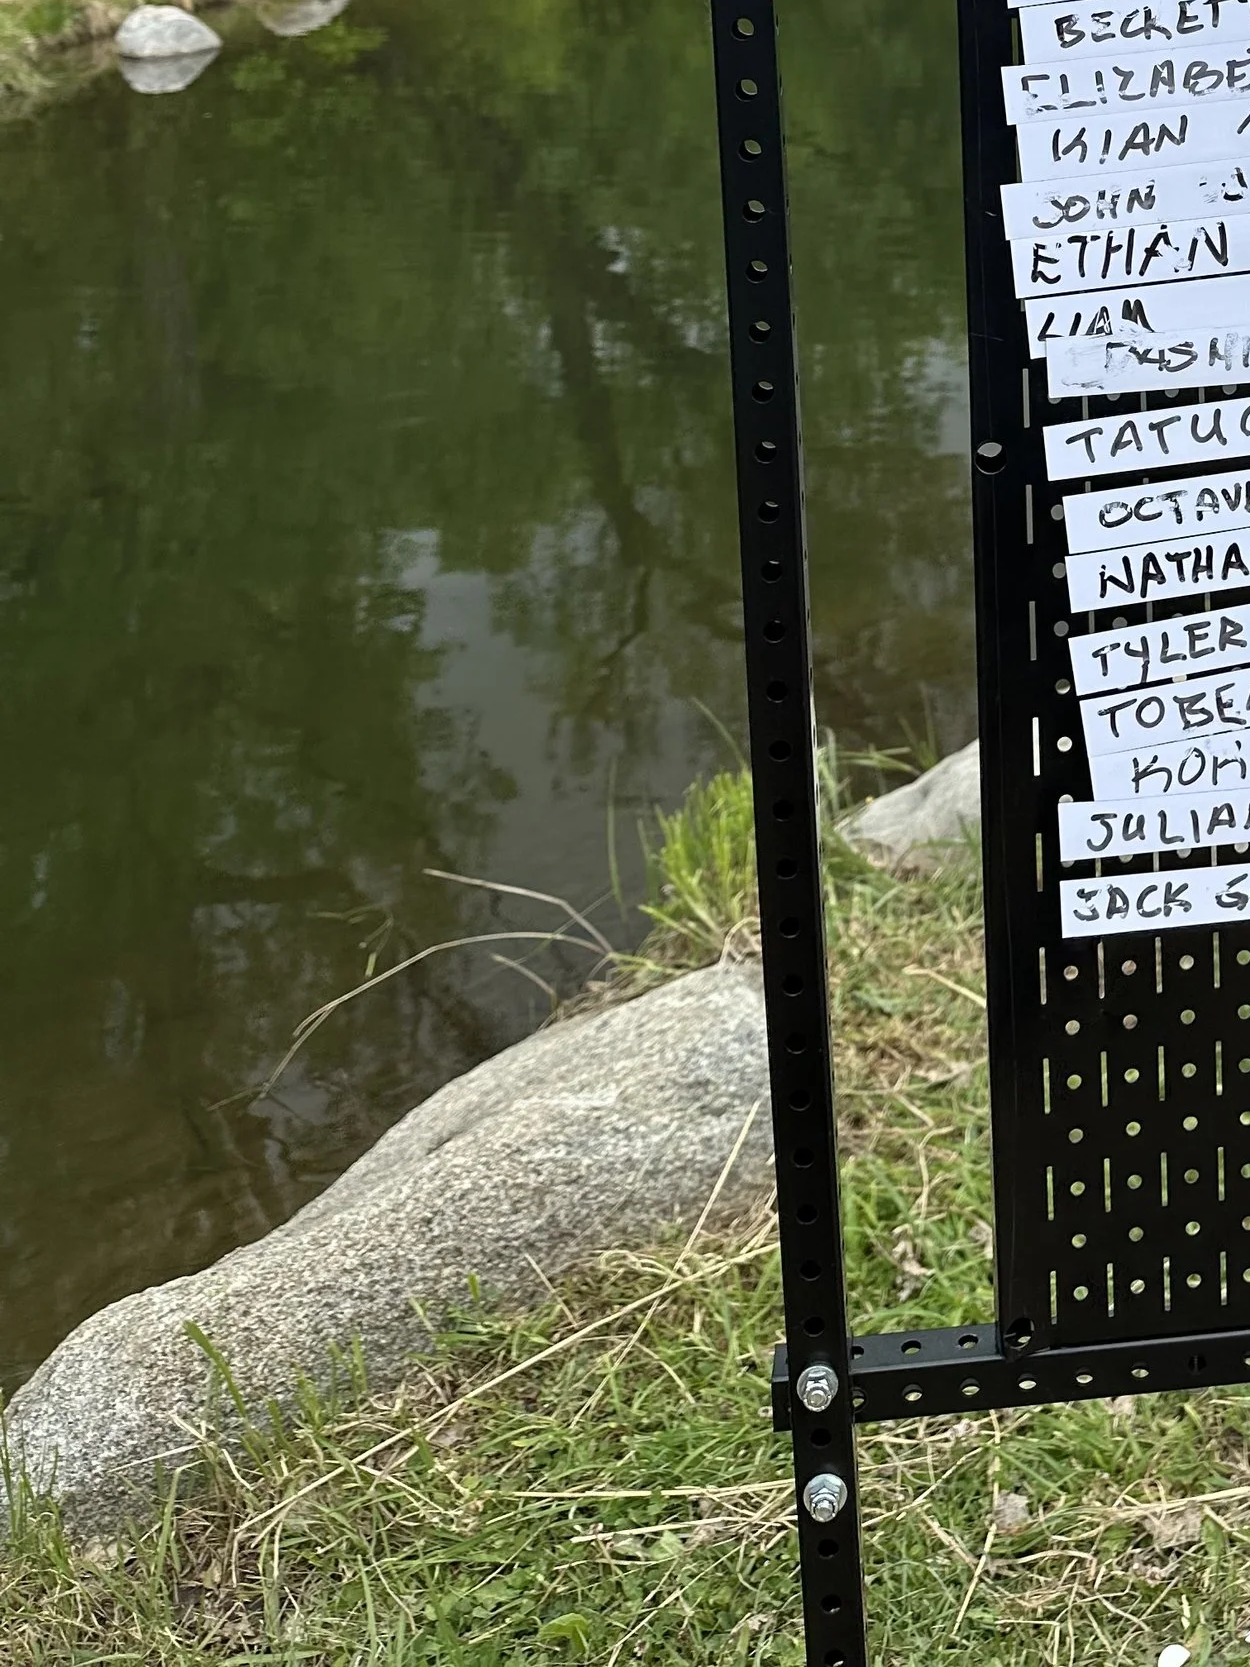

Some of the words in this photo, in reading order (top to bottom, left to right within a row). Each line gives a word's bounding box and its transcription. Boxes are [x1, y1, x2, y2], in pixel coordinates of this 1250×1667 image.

[1050, 114, 1189, 164] KIAN
[1030, 220, 1229, 285] ETHAN
[1091, 616, 1248, 684] TYLER
[1072, 879, 1193, 923] JACK
